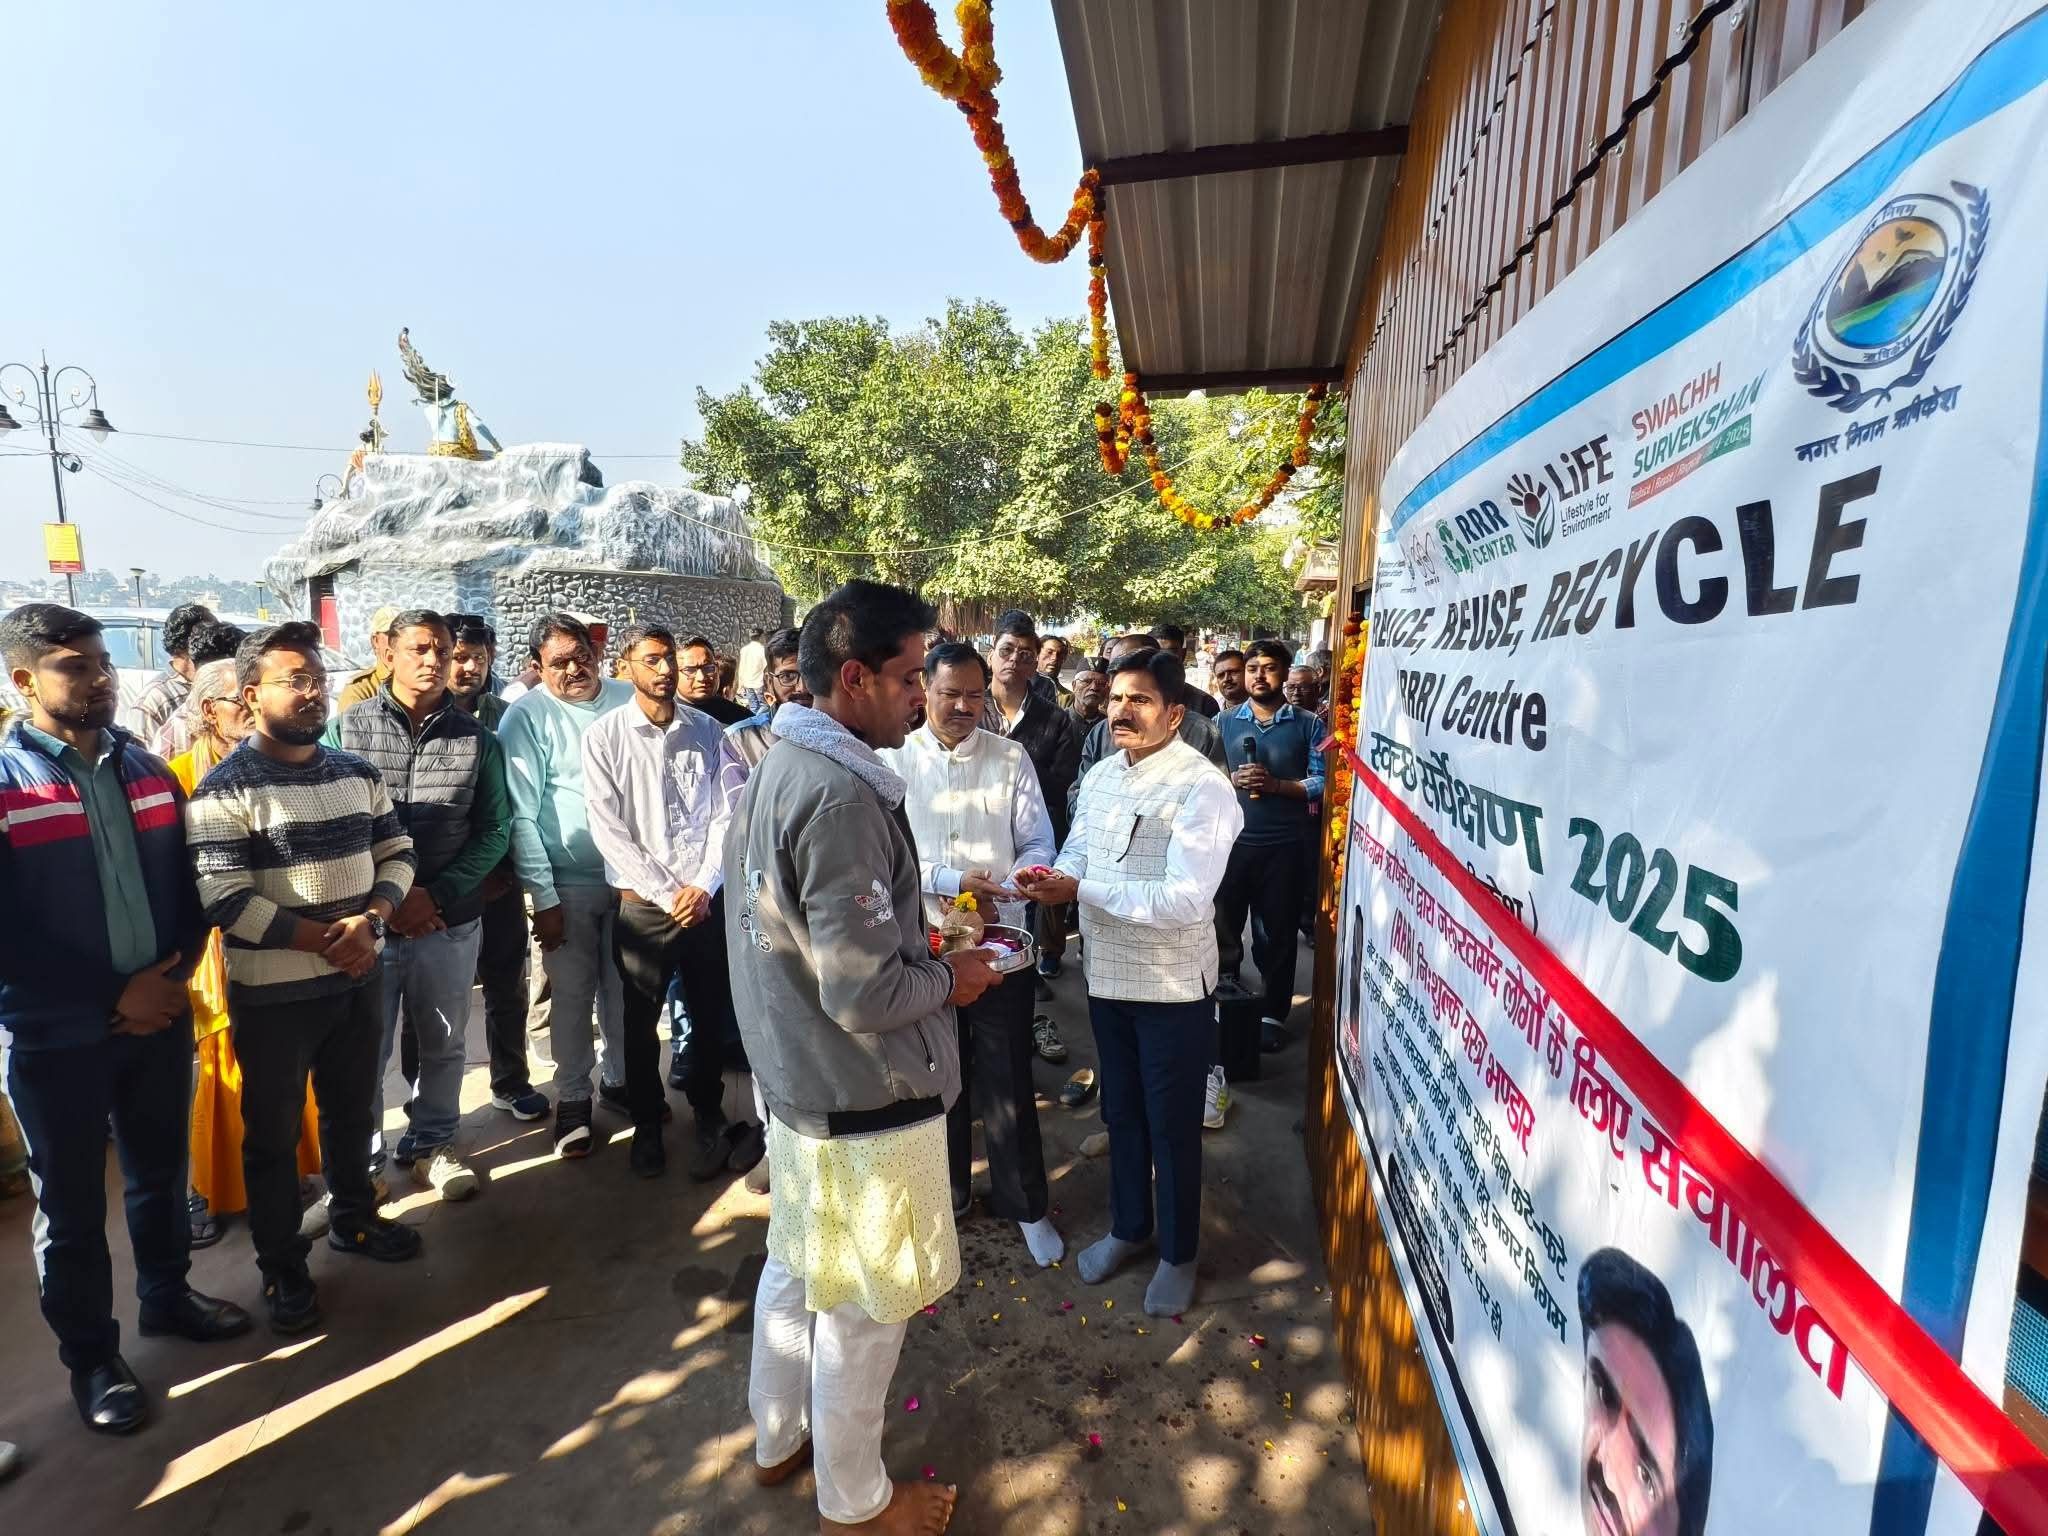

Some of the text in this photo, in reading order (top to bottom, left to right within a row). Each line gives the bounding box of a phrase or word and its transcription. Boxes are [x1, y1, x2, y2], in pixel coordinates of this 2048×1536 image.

[1631, 361, 1722, 441] SWACHH
[1632, 368, 1768, 478] SURVEKSHAN
[1794, 384, 1962, 463] नगर निगम ऋषिकेश
[1543, 433, 1614, 502] LiFE
[1560, 491, 1611, 523] Lifestyle for
[1431, 583, 1528, 657] REUSE,
[1530, 465, 1882, 642] RECYCLE
[1454, 499, 1510, 544] RRR
[1472, 533, 1518, 566] CENTER
[1561, 506, 1612, 538] Environment
[1441, 674, 1547, 752] Centre
[1370, 731, 1418, 792] स्वच्छ
[1415, 750, 1544, 875] सर्वेक्षण
[1568, 816, 1743, 983] 2025
[1416, 882, 1435, 928] द्वारा
[1437, 902, 1503, 997] जरूरतमंद
[1502, 964, 1551, 1053] लोगों
[1546, 1014, 1568, 1079] के
[1569, 1036, 1633, 1161] लिए
[1392, 976, 1413, 1013] अनुरोध
[1412, 996, 1419, 1022] है
[1417, 1004, 1427, 1034] कि
[1427, 1024, 1443, 1062] अपने
[1441, 1048, 1457, 1090] पुराने
[1456, 1075, 1473, 1117] साफ
[1473, 1104, 1492, 1156] सुथरे
[1491, 1134, 1512, 1195] बिना
[1511, 1178, 1568, 1282] कटे-फटे
[1461, 1008, 1488, 1076] वस्त्र
[1485, 1052, 1536, 1157] भण्डार
[1394, 1018, 1405, 1044] को
[1446, 1107, 1457, 1136] के
[1454, 1124, 1479, 1190] उपयोग
[1476, 1168, 1490, 1228] हेतु
[1491, 1203, 1523, 1270] नगर
[1524, 1246, 1567, 1344] निगम
[1431, 1178, 1438, 1211] से
[1439, 1201, 1459, 1255] अपने
[1460, 1241, 1474, 1285] घर
[1475, 1269, 1490, 1316] पर
[1490, 1300, 1503, 1342] ही
